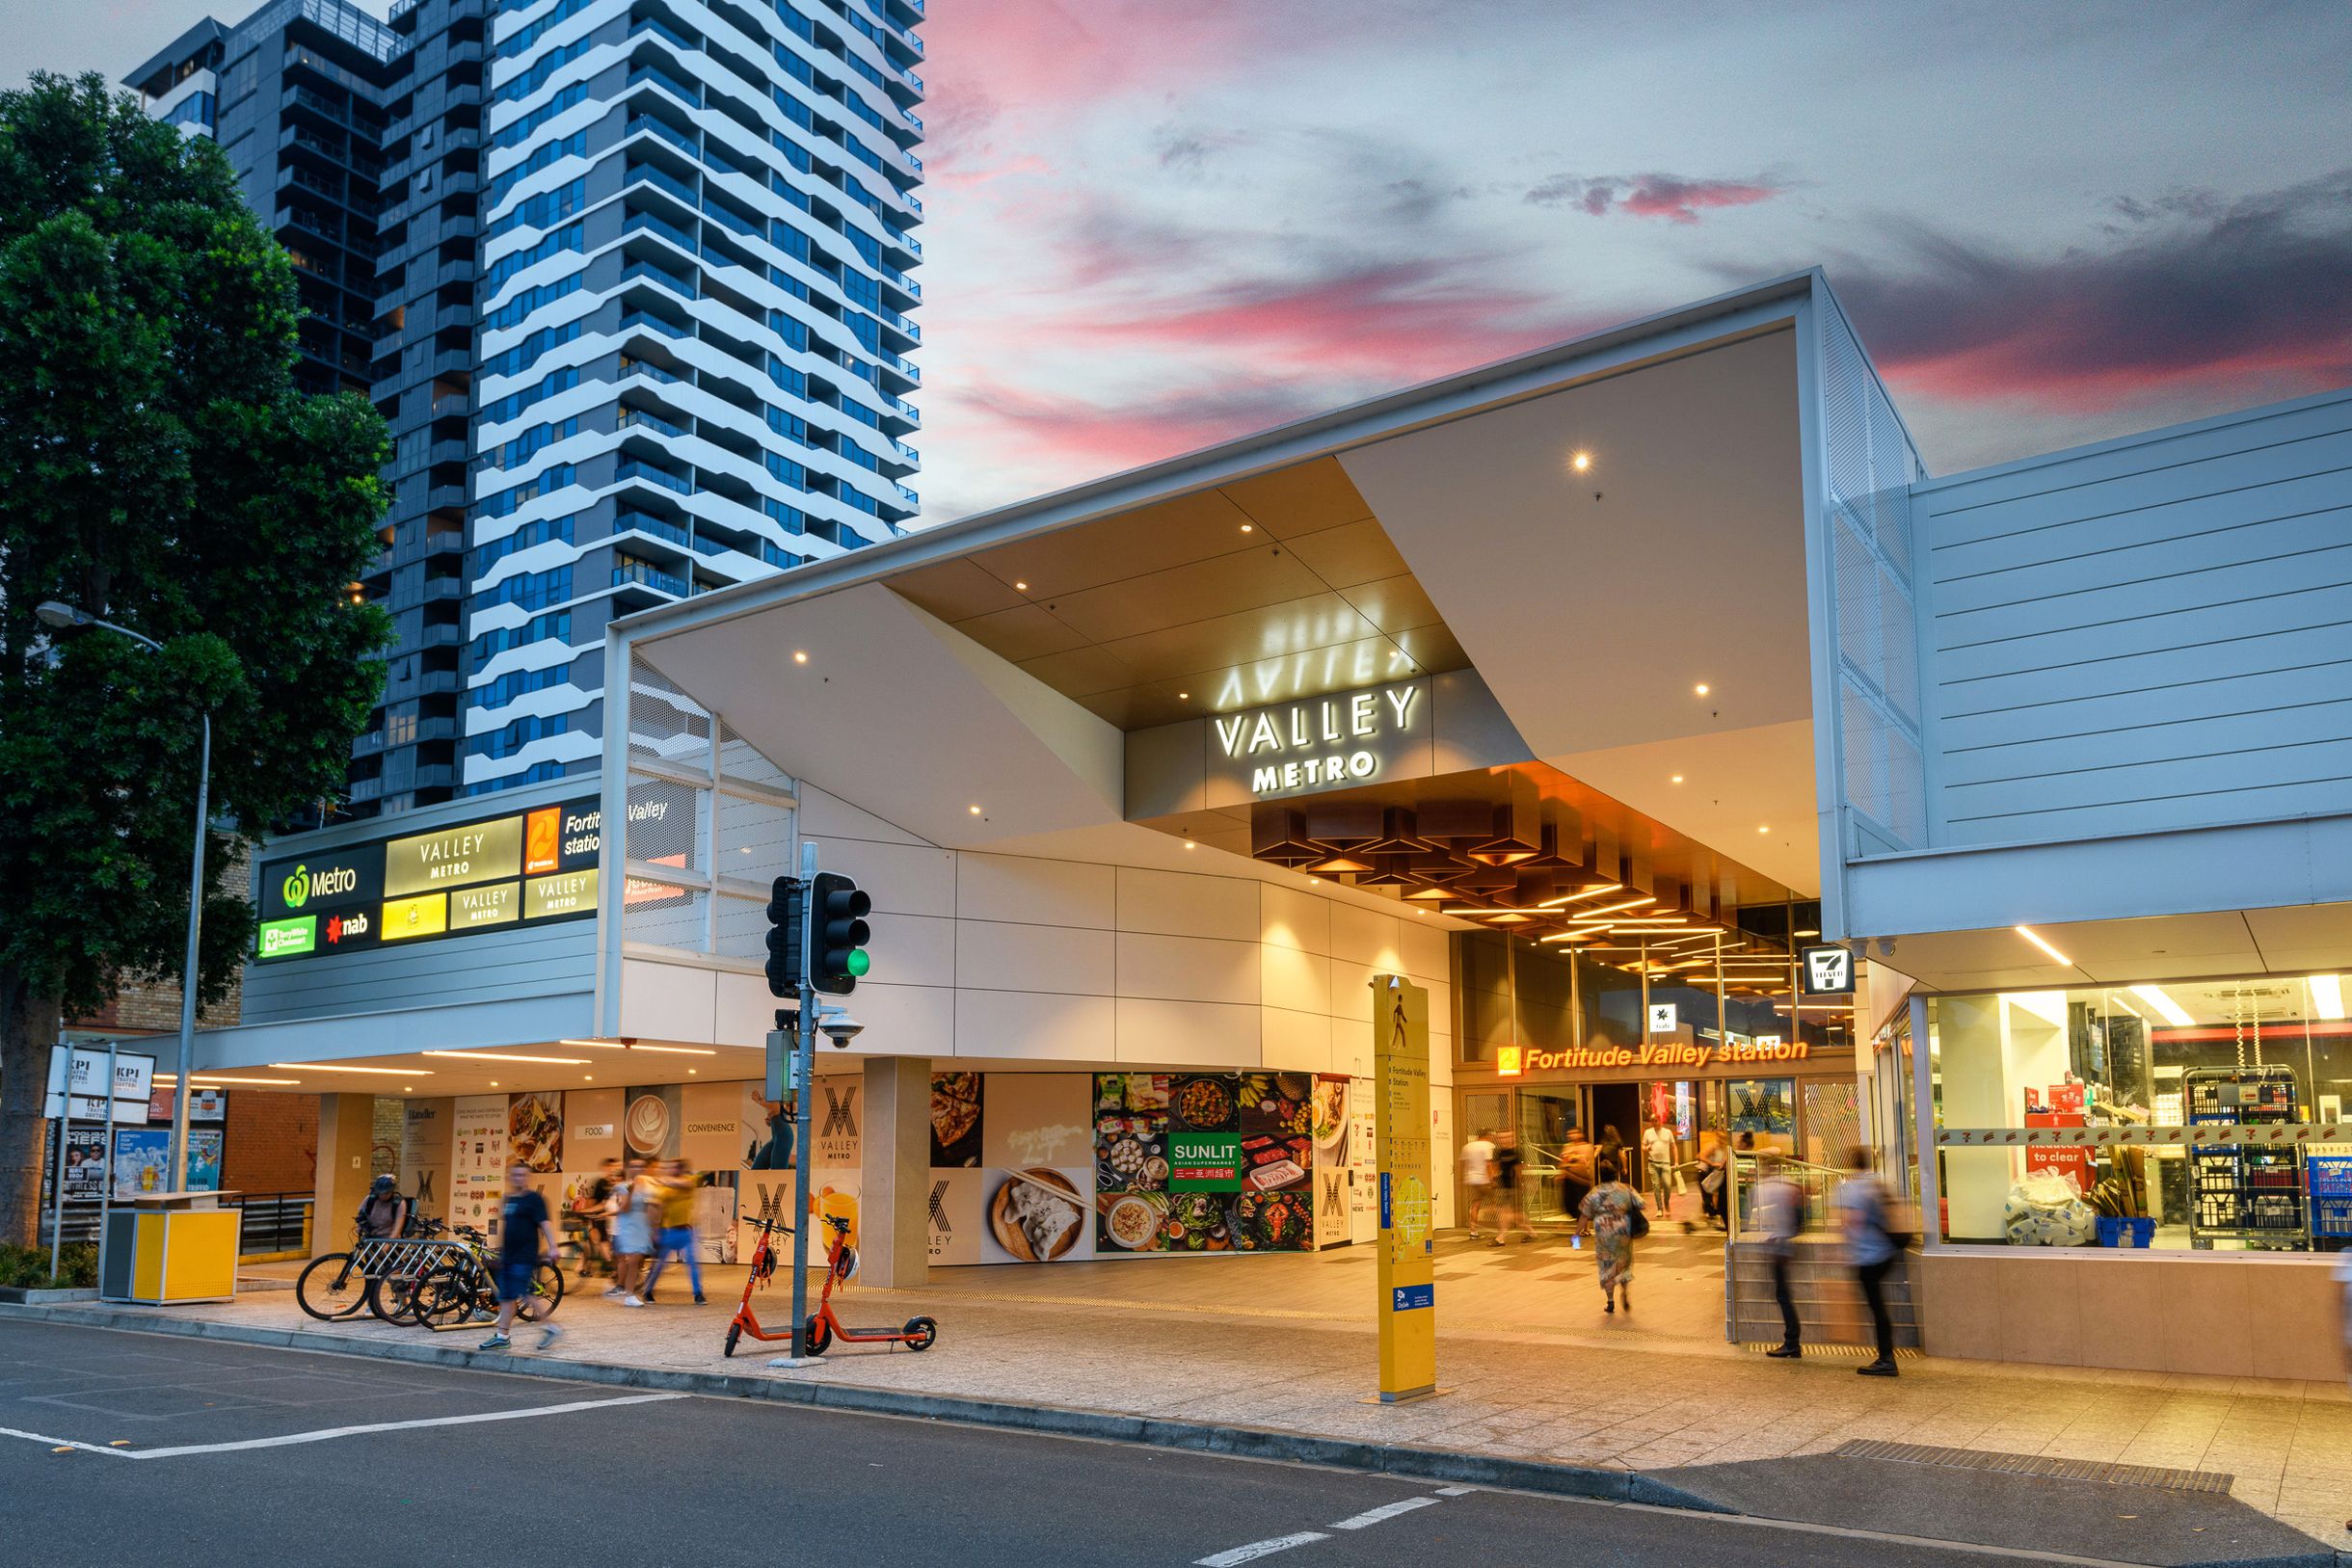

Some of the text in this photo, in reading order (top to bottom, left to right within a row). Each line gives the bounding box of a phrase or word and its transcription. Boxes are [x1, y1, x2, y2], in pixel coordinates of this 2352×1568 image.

[1216, 686, 1415, 757] VALLEY
[1253, 752, 1376, 793] METRO
[628, 800, 668, 821] Valley
[420, 833, 484, 863] VALLEY
[564, 834, 601, 856] statio
[430, 861, 469, 880] METRO
[311, 866, 357, 897] Metro
[538, 877, 586, 898] VALLEY
[463, 889, 508, 910] VALLEY
[547, 896, 577, 910] METRO
[470, 908, 498, 921] METRO
[342, 913, 368, 936] nab
[1525, 1039, 1808, 1070] Fortitude Valley station
[117, 1067, 139, 1077] KPI
[1393, 1066, 1427, 1079] Fortitude Valley
[1393, 1077, 1408, 1087] Station
[585, 1127, 603, 1136] FOOD
[687, 1123, 735, 1133] CONVENIENCE
[820, 1141, 858, 1151] VALLEY
[1175, 1145, 1237, 1158] SUNLIT
[2034, 1151, 2078, 1162] to clear
[1322, 1219, 1344, 1229] VALLEY
